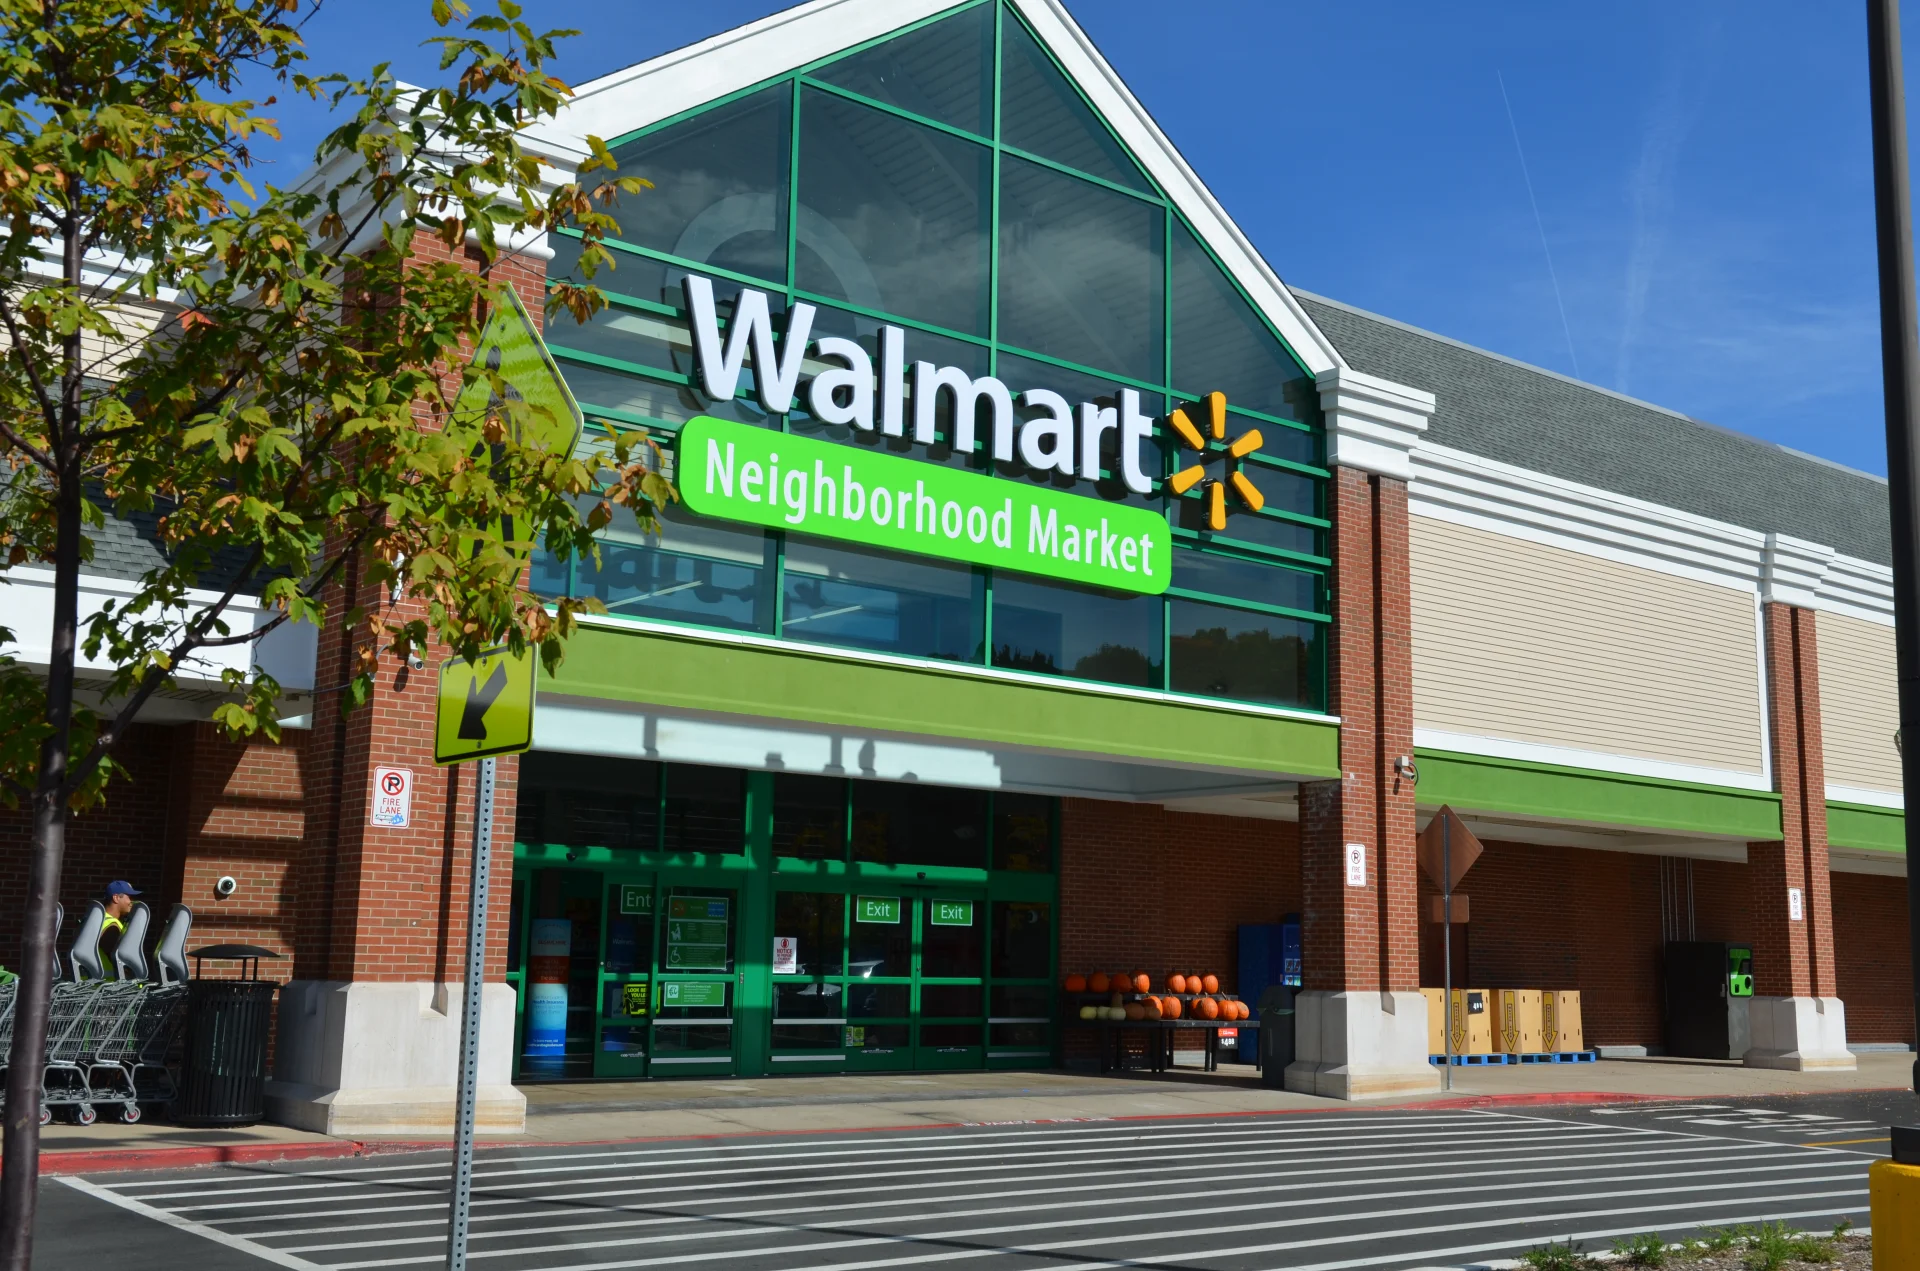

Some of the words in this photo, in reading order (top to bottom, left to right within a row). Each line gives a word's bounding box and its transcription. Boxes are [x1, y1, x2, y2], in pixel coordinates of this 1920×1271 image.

[683, 273, 1153, 494] Walmart
[704, 438, 1013, 550] Neighborhood
[1028, 504, 1154, 576] Market
[380, 806, 402, 814] LANE
[382, 798, 401, 806] FIRE
[626, 891, 668, 908] Entr
[866, 901, 890, 917] Exit
[941, 904, 963, 919] Exit
